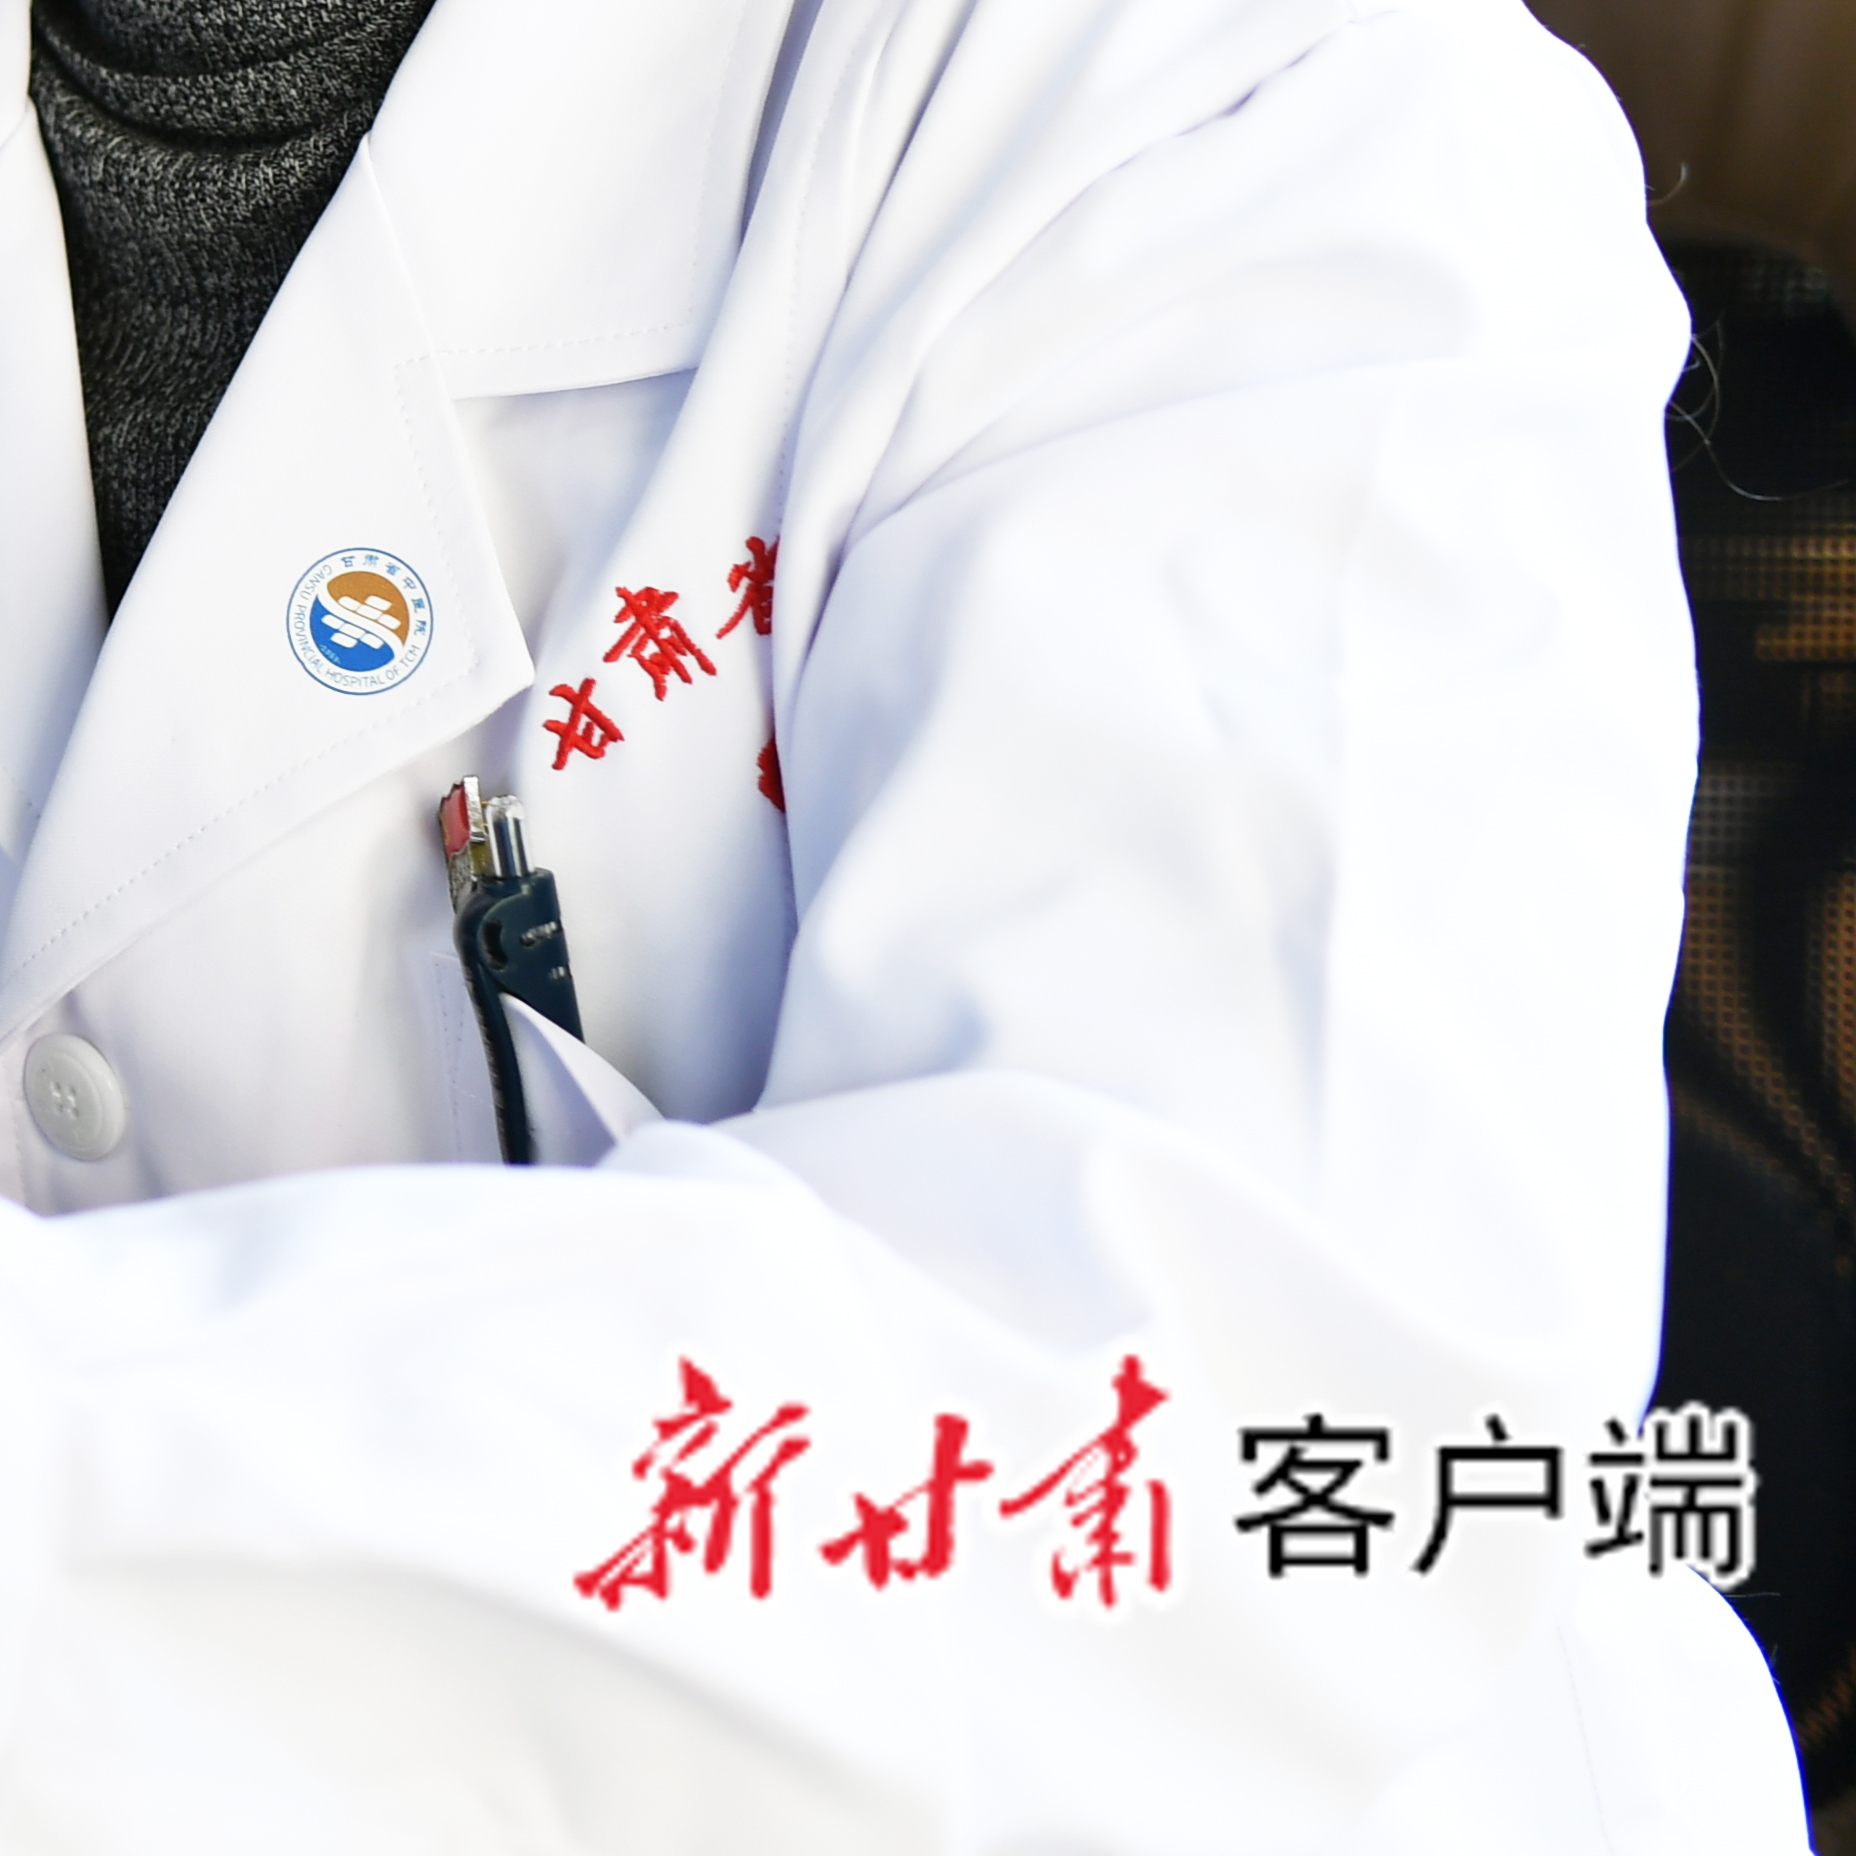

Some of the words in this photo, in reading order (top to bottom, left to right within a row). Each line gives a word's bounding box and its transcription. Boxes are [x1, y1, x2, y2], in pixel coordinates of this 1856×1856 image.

[300, 564, 333, 600] GANSU
[293, 604, 324, 674] PROVINCIAL
[401, 644, 421, 668] TCM
[326, 668, 385, 688] HOSPITAL
[385, 668, 400, 681] OF
